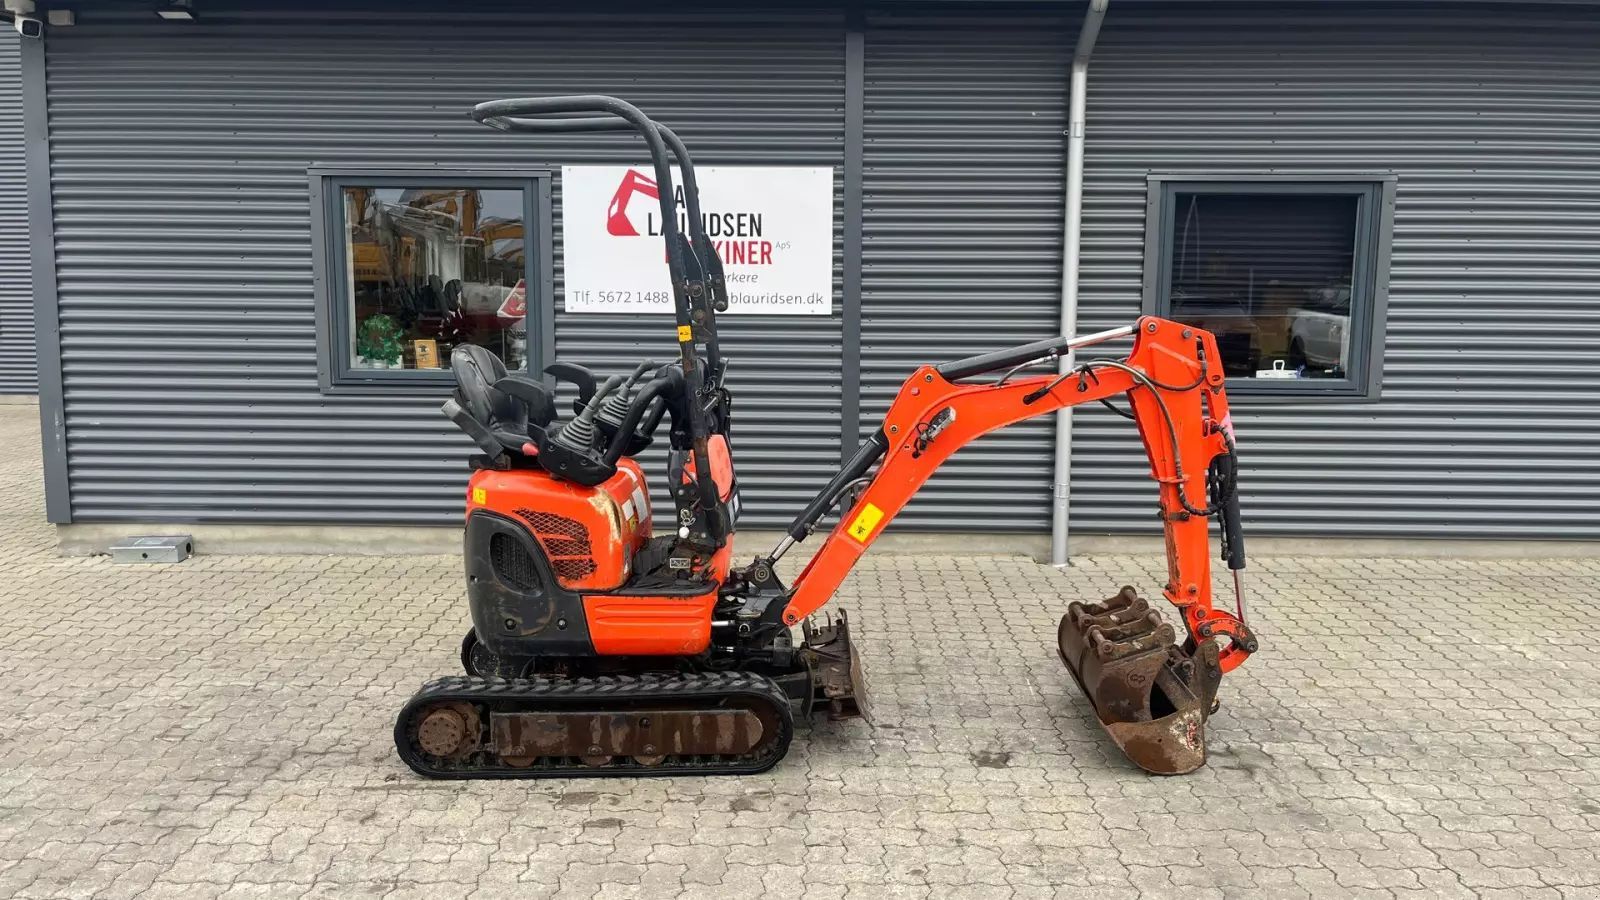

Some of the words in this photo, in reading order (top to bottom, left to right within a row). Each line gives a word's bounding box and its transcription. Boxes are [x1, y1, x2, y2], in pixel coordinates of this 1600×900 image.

[648, 212, 762, 237] LIDSEN
[665, 241, 773, 265] KINER
[775, 241, 791, 250] ApS
[724, 272, 759, 283] rkere
[573, 290, 594, 305] Tlf.
[598, 291, 631, 303] 5672
[636, 291, 669, 303] 1488
[727, 292, 825, 305] blauridsen.dk
